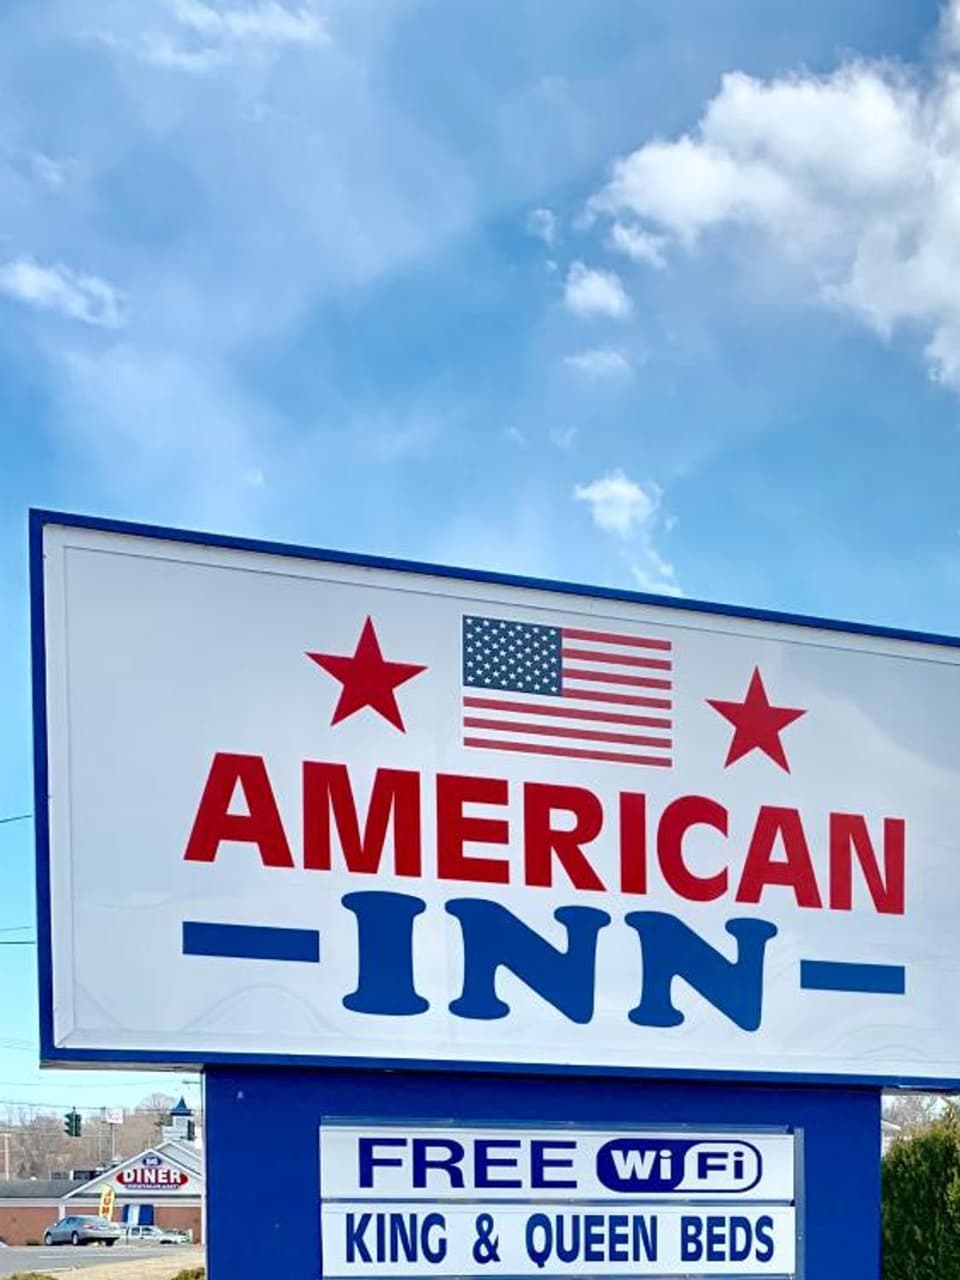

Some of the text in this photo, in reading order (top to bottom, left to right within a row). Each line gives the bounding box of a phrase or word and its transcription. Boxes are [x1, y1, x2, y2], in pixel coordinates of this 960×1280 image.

[184, 752, 906, 916] AMERICAN
[339, 889, 781, 1034] INN
[123, 1168, 182, 1184] DINER
[358, 1137, 578, 1189] FREE
[345, 1212, 775, 1269] KING & QUEEN BEDS
